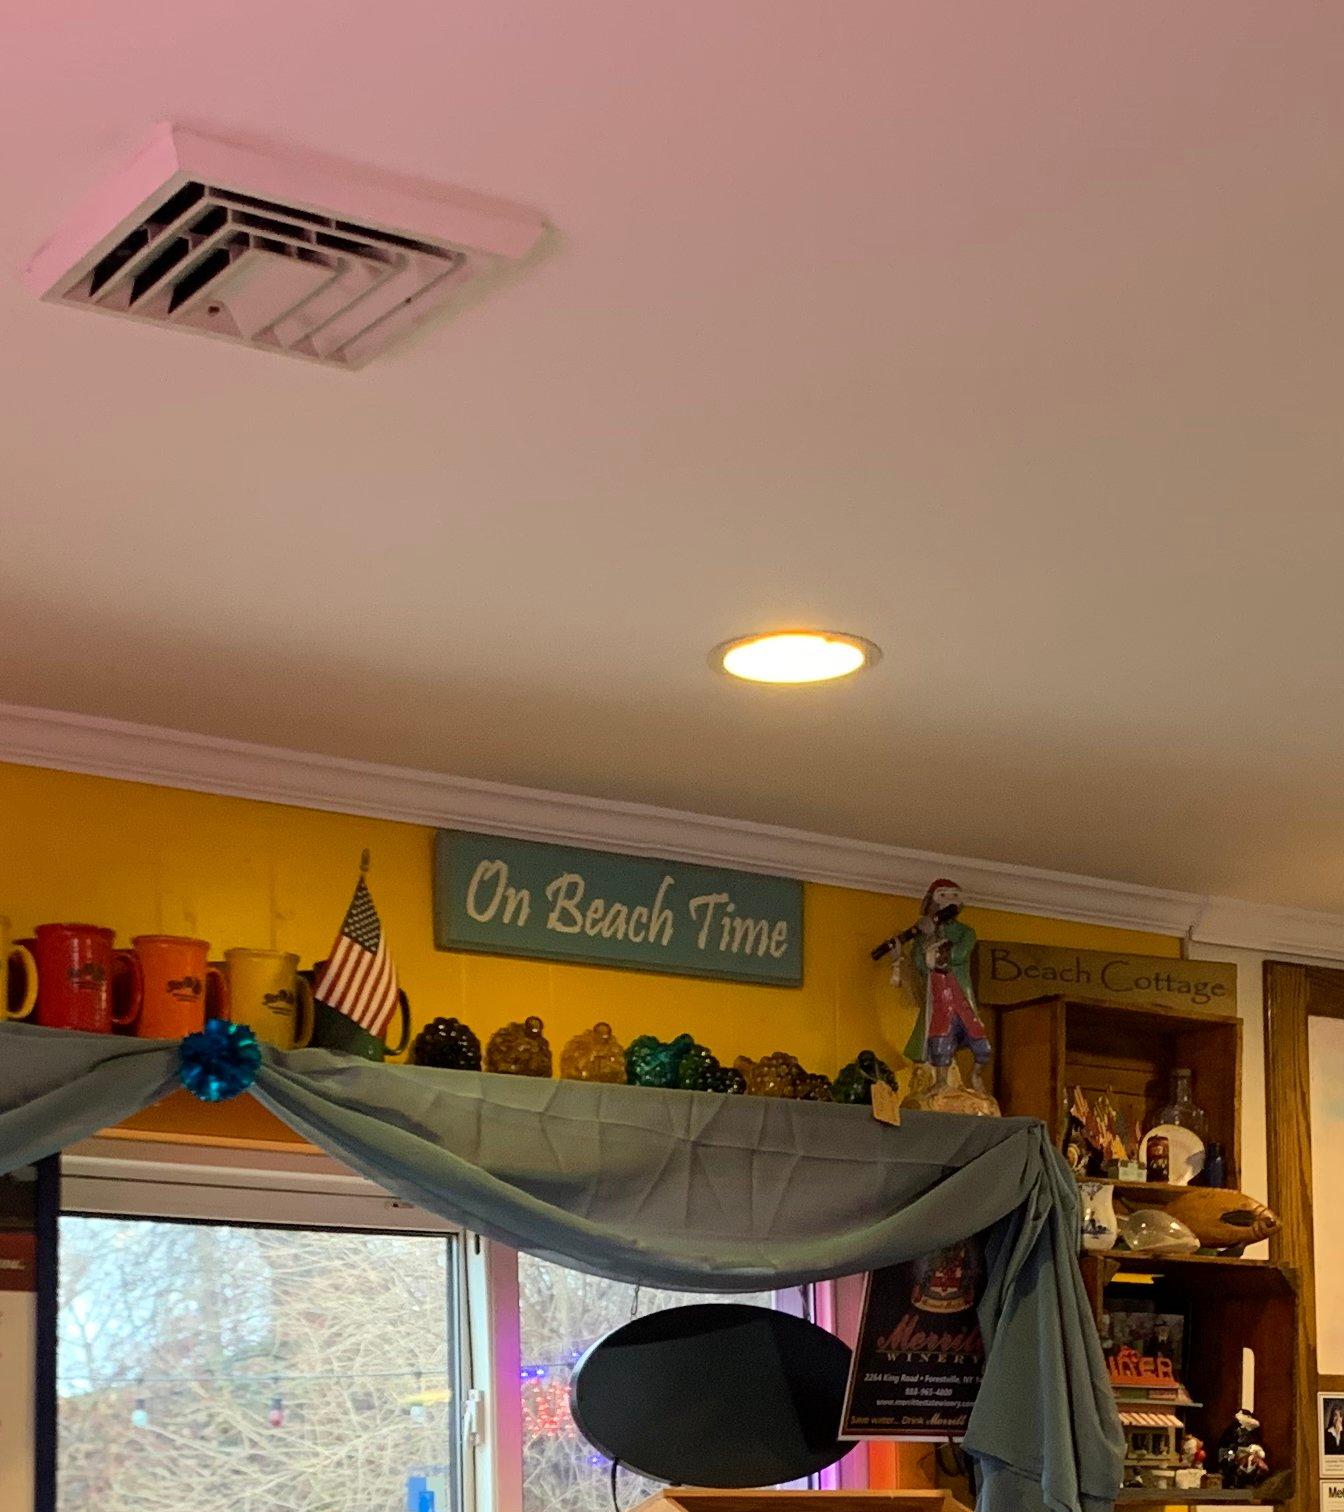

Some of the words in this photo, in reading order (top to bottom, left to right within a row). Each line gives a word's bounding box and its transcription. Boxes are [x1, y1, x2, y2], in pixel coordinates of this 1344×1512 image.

[465, 858, 532, 929] On
[546, 872, 676, 947] Beach
[688, 891, 788, 959] Time
[990, 949, 1092, 985] Beach
[1100, 960, 1228, 1005] Cottage
